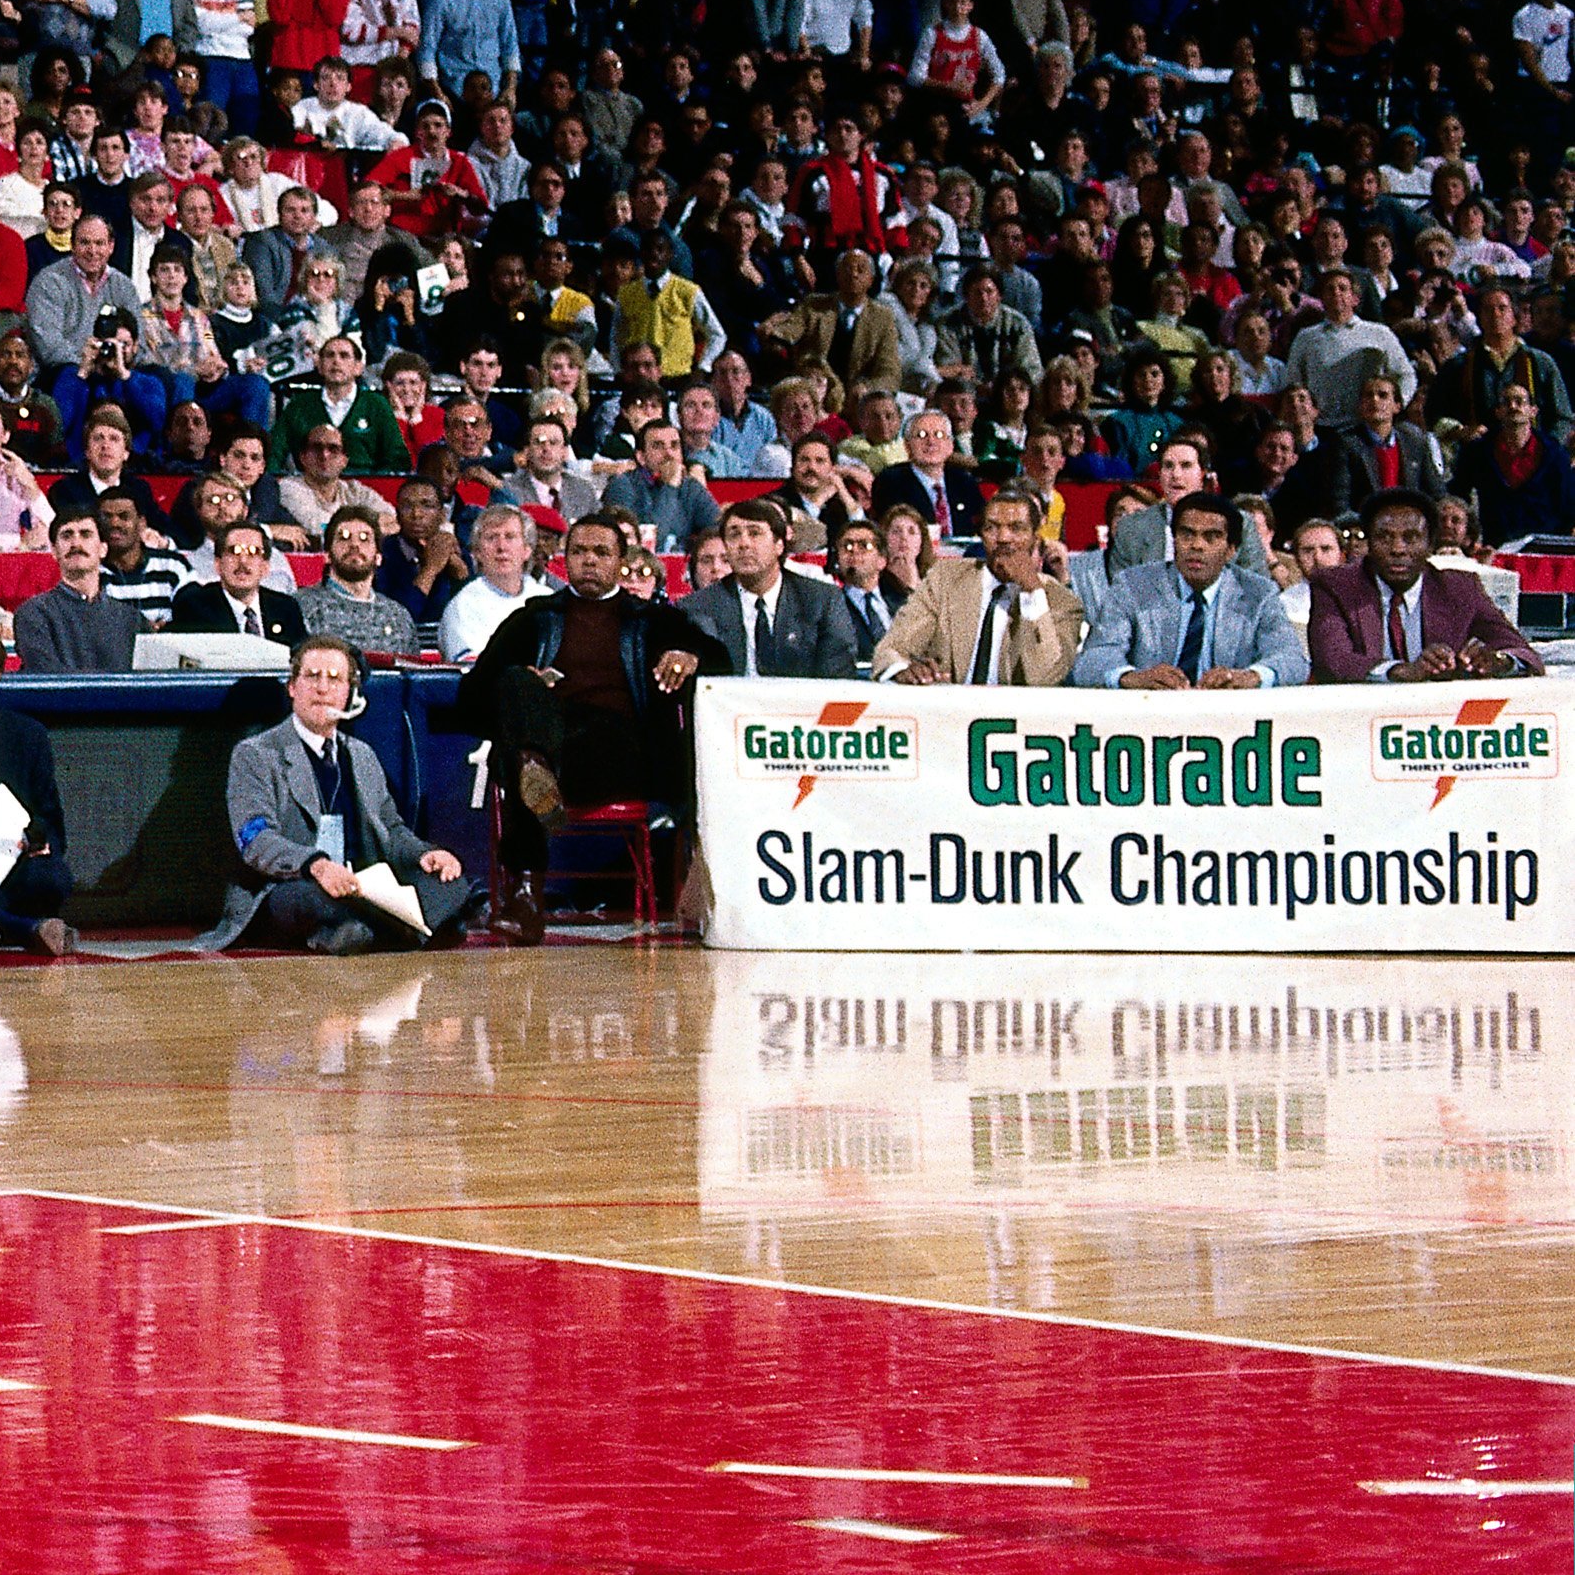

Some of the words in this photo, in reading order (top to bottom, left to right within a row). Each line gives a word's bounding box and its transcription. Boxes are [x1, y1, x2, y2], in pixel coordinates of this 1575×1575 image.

[743, 722, 911, 763] Gatorade
[1379, 720, 1551, 762] Gatorade
[763, 763, 810, 773] THIRST
[813, 763, 892, 774] QUENCHER
[966, 717, 1324, 807] Gatorade
[1400, 762, 1448, 773] THIRST
[1452, 761, 1531, 772] QUENCHER
[756, 829, 1085, 907] Slam-Dunk
[1110, 831, 1540, 922] Championship
